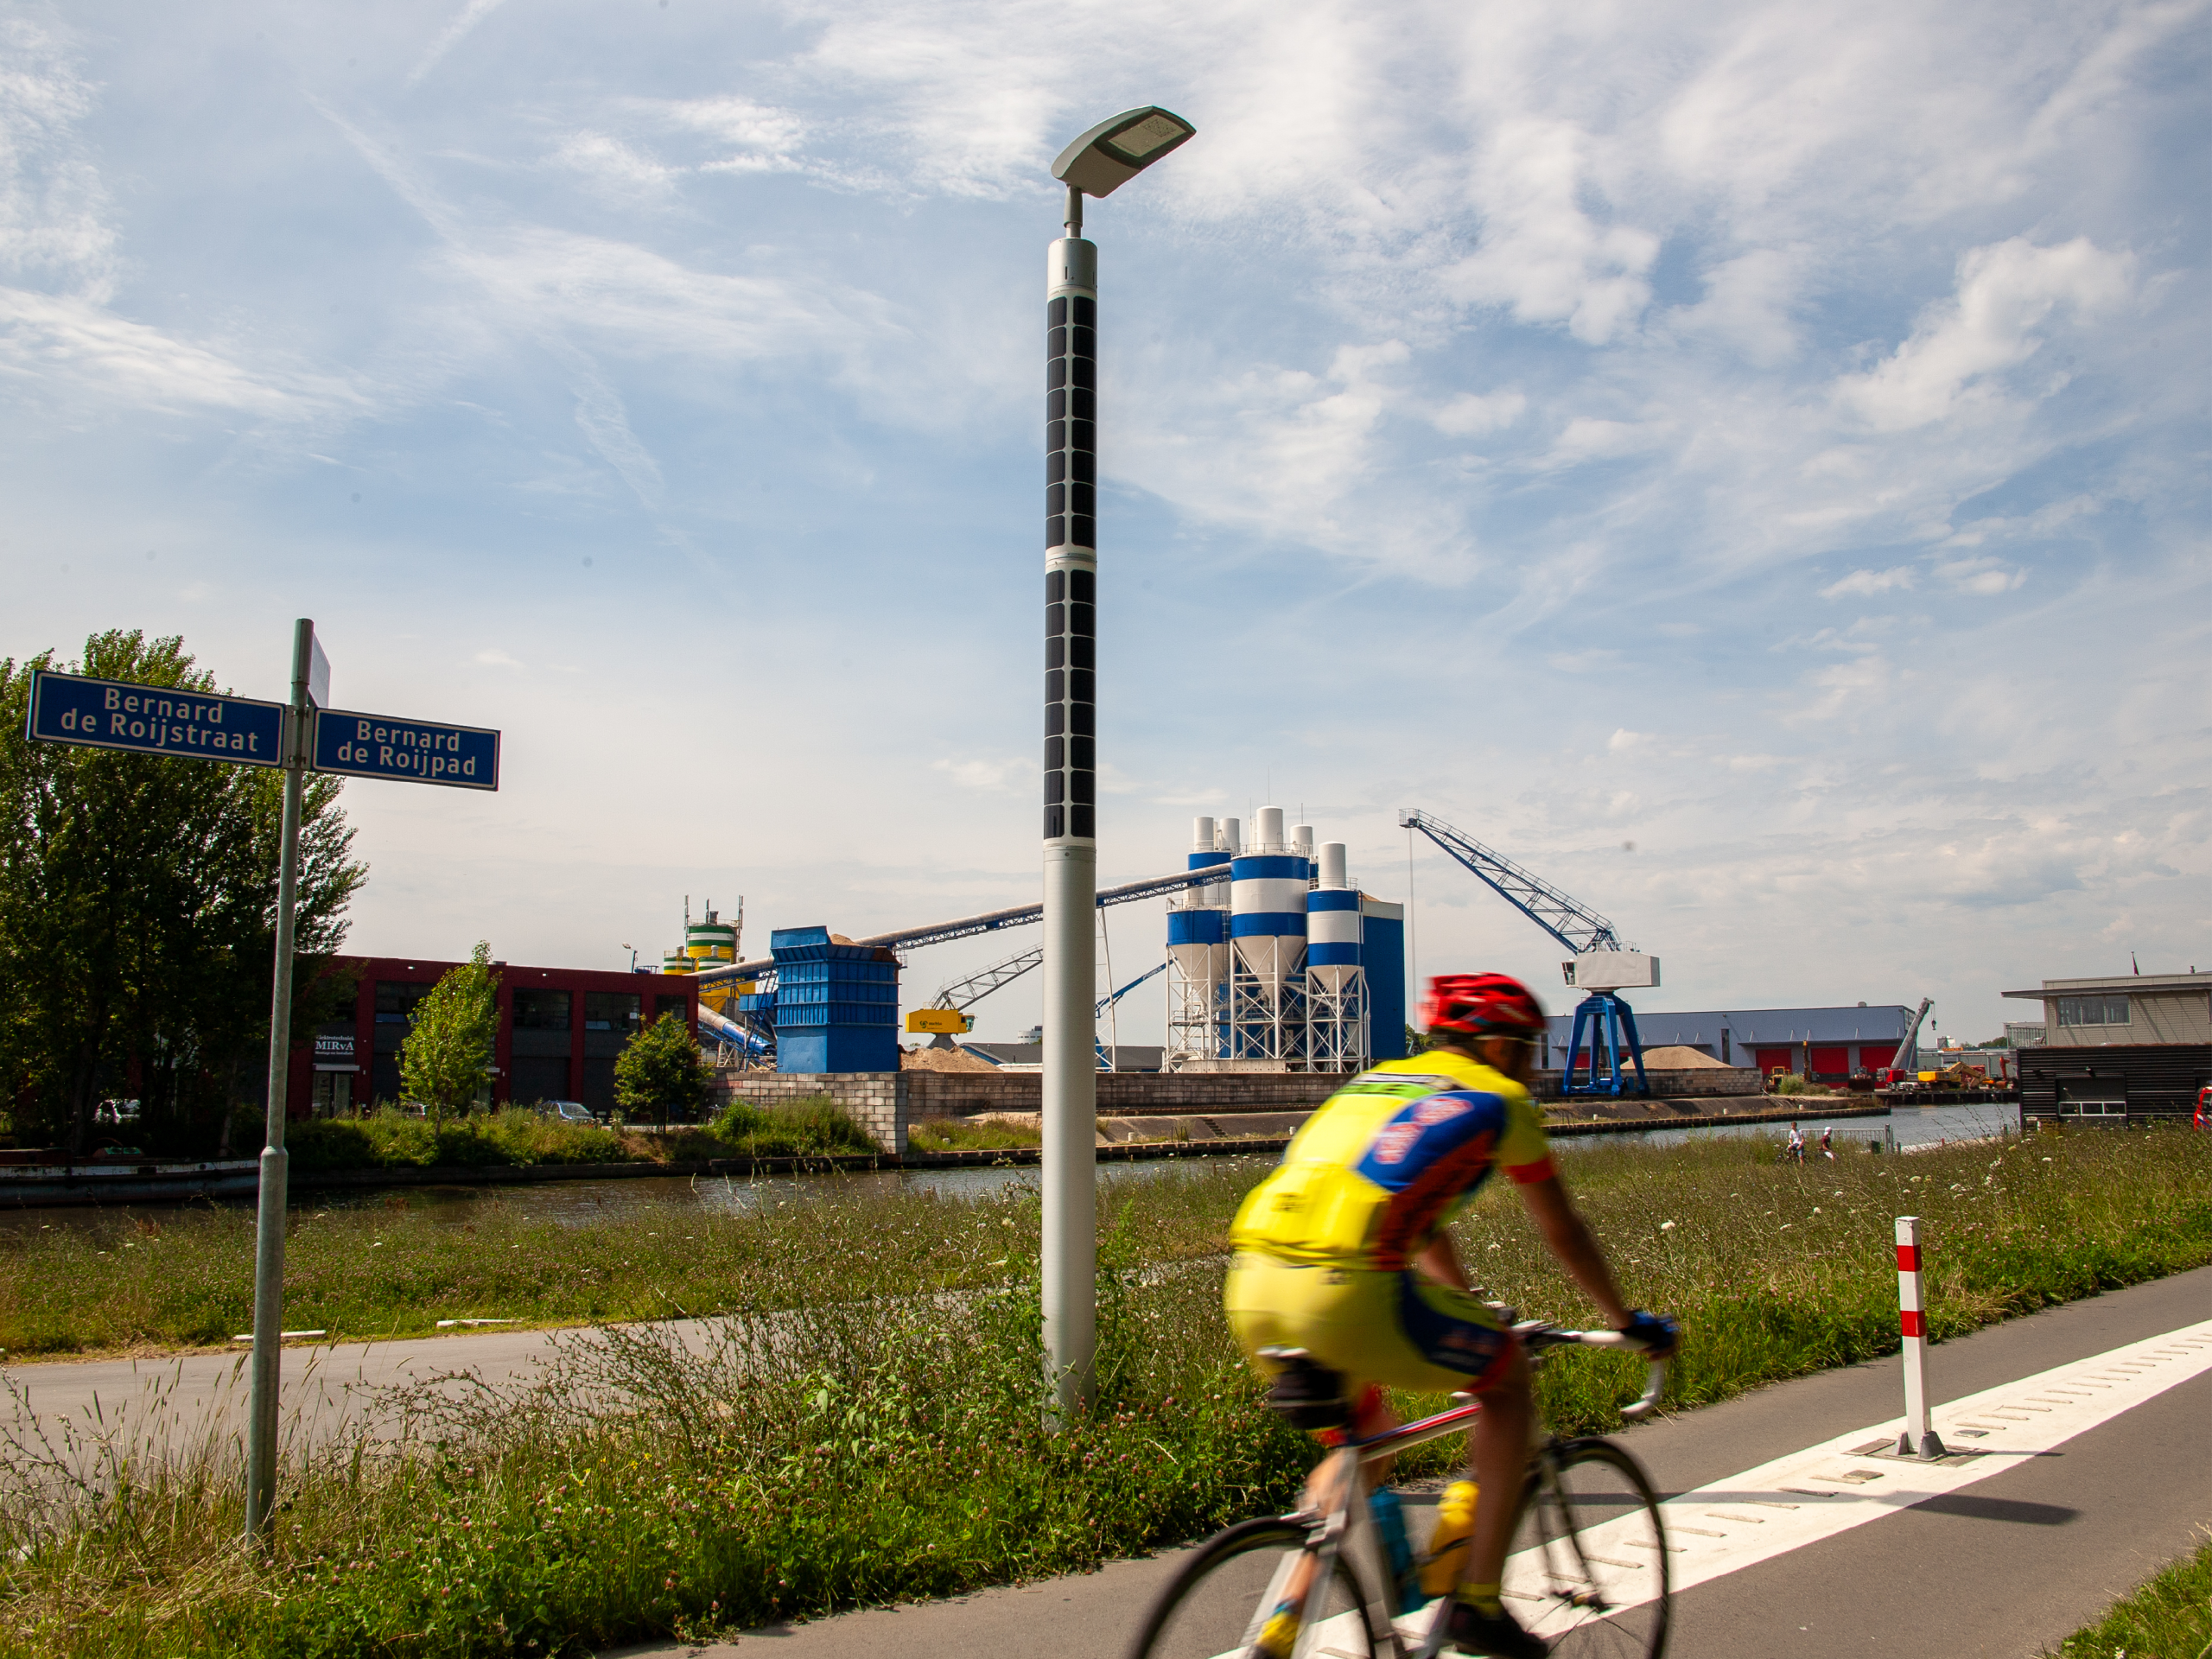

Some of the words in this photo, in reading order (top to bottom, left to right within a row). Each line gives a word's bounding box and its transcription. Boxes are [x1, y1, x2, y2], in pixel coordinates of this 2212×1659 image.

[105, 687, 223, 723] Bernard
[60, 708, 97, 732] de
[111, 713, 258, 752] Roijstraat
[357, 720, 460, 752] Bernard
[337, 741, 368, 763] de
[379, 746, 475, 777] Roijpad
[315, 1040, 354, 1051] MIRvA
